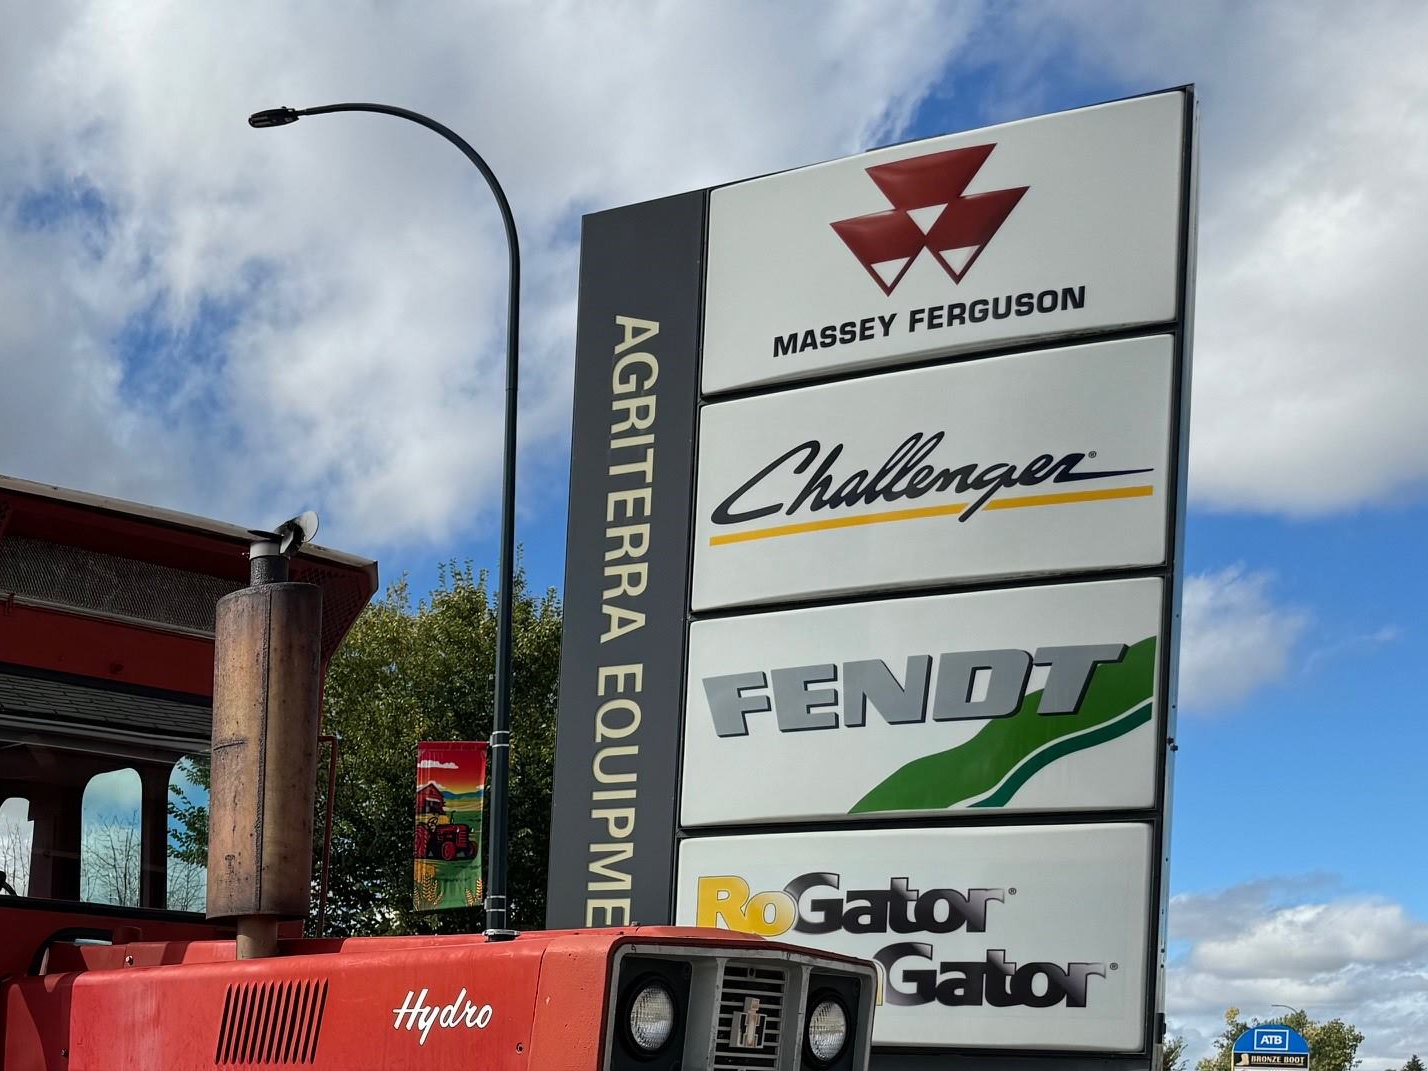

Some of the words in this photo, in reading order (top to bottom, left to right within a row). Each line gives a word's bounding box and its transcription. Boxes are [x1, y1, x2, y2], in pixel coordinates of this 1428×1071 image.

[772, 313, 898, 358] MASSEY
[908, 286, 1086, 333] FERGUSON
[598, 314, 659, 643] AGRITERRA
[710, 431, 1153, 522] Challenger
[702, 643, 1129, 738] FENDT
[695, 872, 1005, 938] RoGator
[874, 941, 1107, 1008] Gator
[392, 987, 493, 1045] Hydro
[1260, 1035, 1283, 1045] ATB
[1283, 1056, 1305, 1064] BOOT
